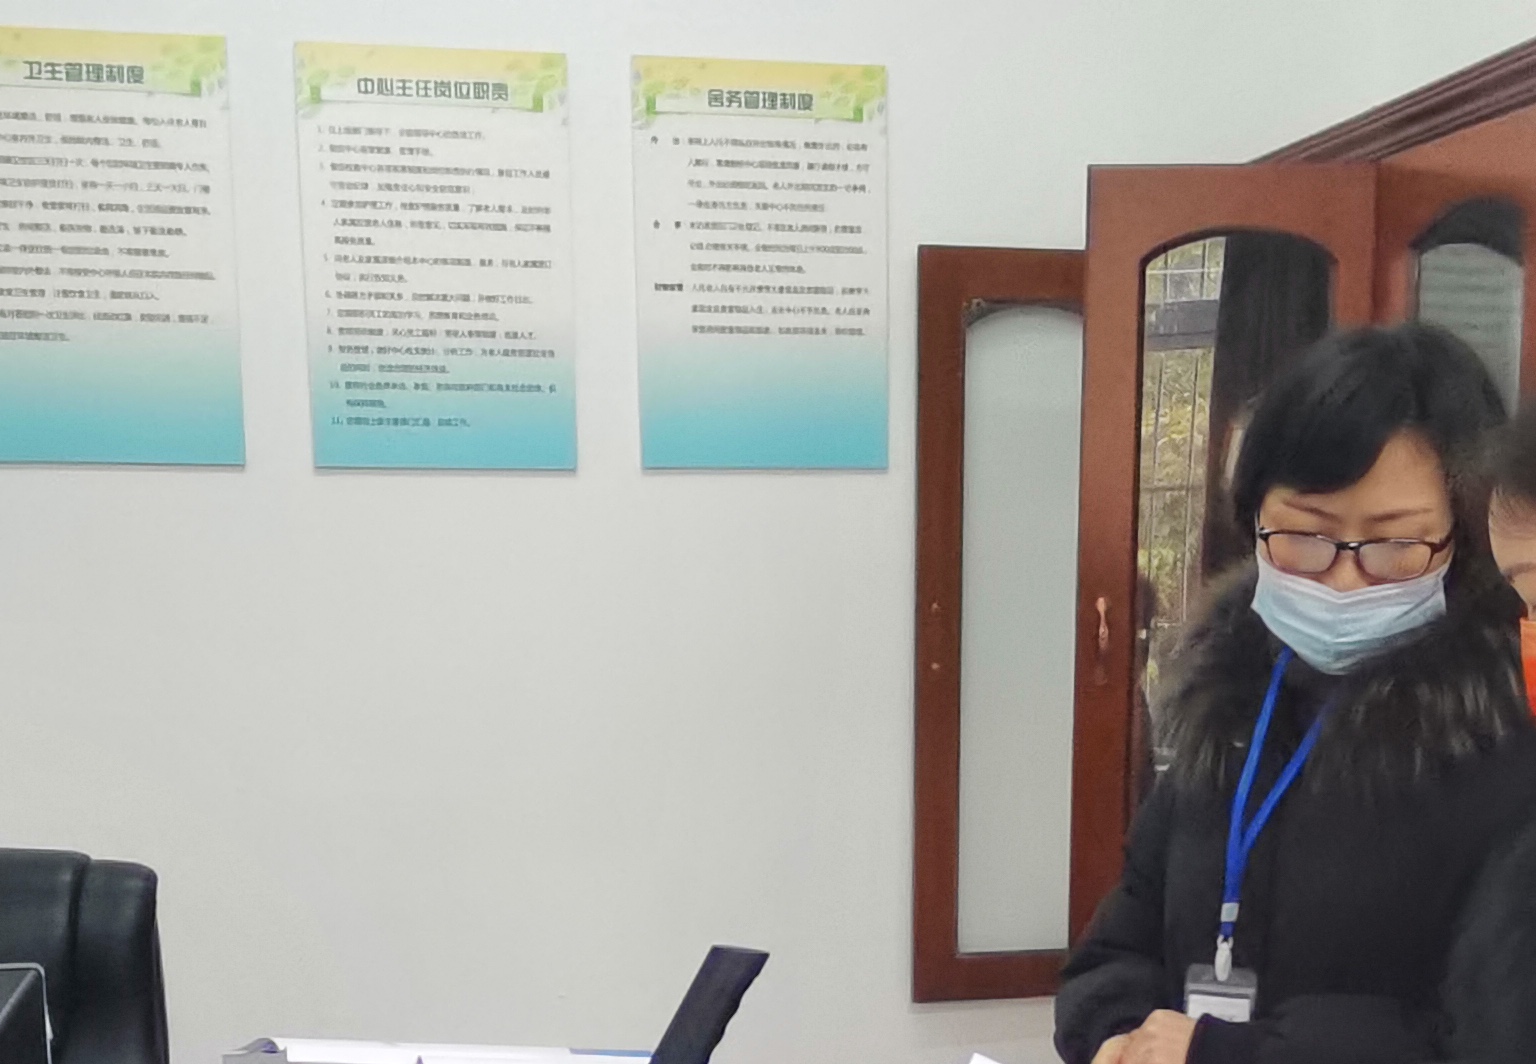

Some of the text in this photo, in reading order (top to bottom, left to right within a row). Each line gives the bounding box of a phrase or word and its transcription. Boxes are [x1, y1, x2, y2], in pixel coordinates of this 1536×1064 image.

[22, 60, 145, 84] 卫生管理制度
[356, 77, 509, 101] 中心主任岗位职责
